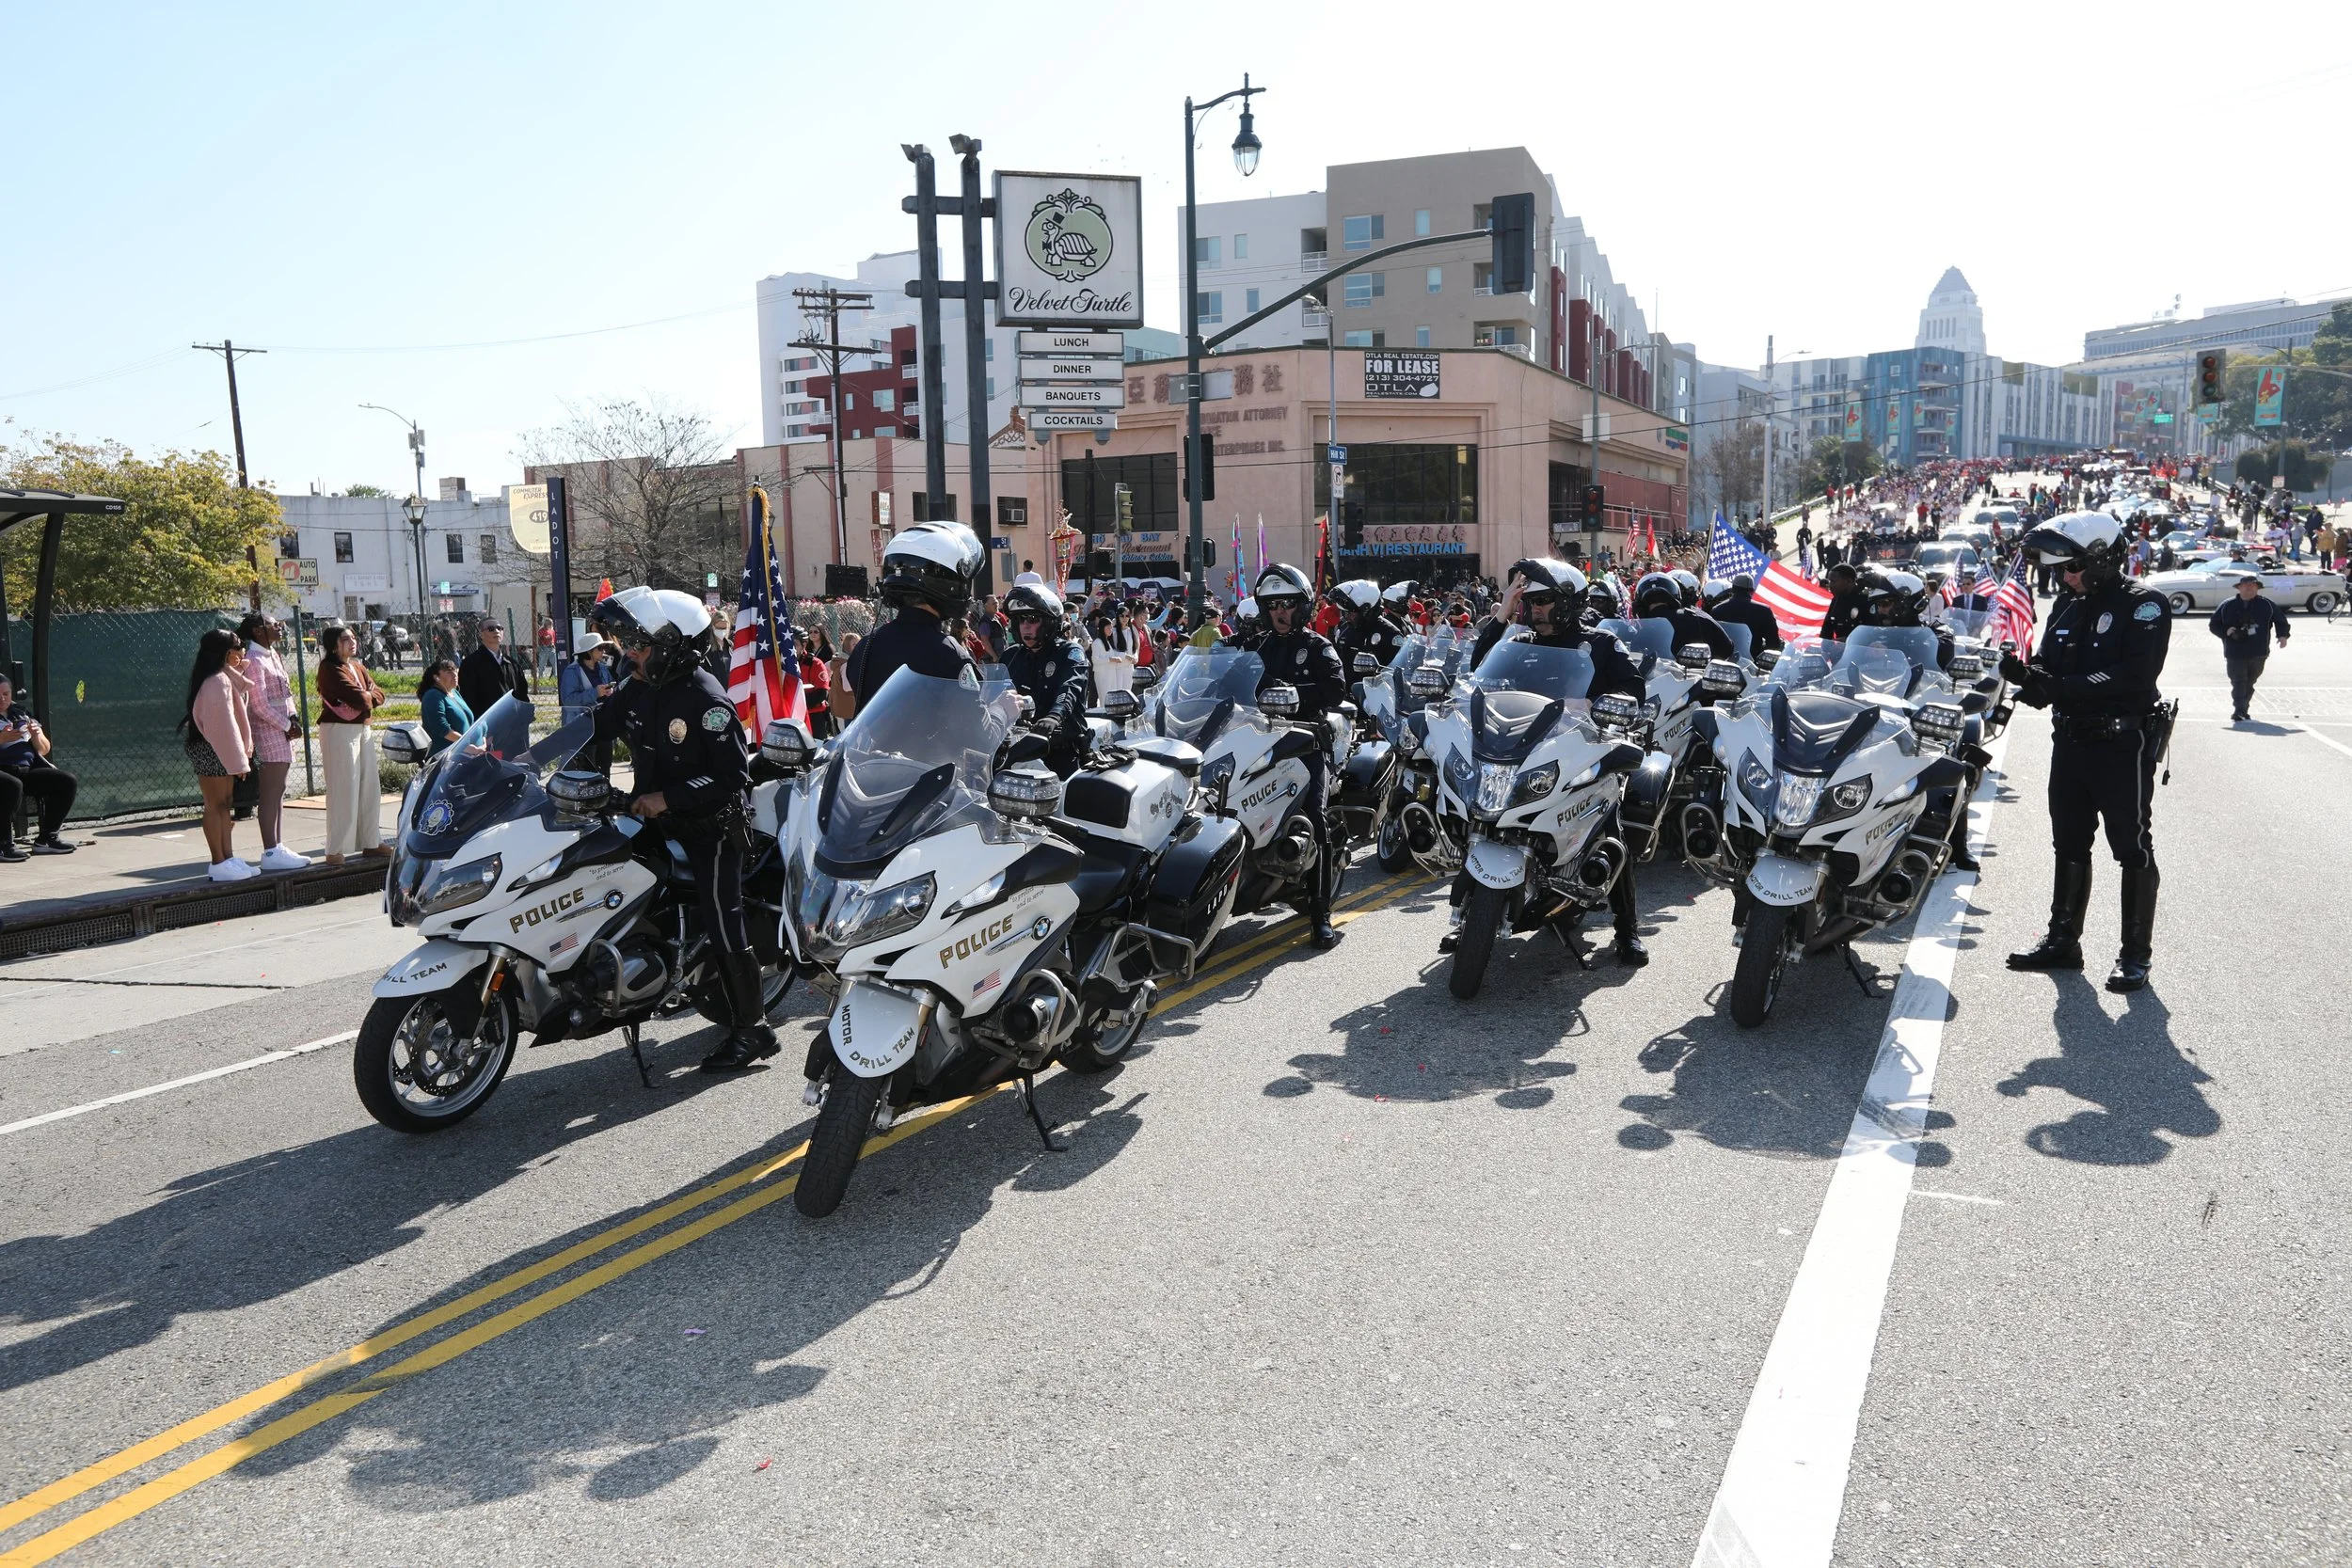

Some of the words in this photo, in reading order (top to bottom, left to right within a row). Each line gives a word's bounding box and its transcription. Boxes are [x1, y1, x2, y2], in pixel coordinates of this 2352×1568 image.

[1009, 287, 1071, 312] Velvet
[1070, 289, 1132, 313] Turtle
[1054, 338, 1089, 347] LUNCH
[1053, 365, 1091, 373] DINNER
[1365, 359, 1392, 373] FOR
[1397, 360, 1438, 373] LEASE
[1366, 383, 1417, 391] DTLA
[1045, 391, 1101, 401] BANQUETS
[1044, 416, 1104, 425] COCKTAILS
[1243, 406, 1289, 421] ATTORNEY
[1339, 451, 1345, 460] St
[532, 512, 548, 521] 419
[1386, 542, 1467, 556] RESTAURANT
[707, 707, 730, 718] ANGELES
[1241, 779, 1278, 813] POLICE
[1557, 793, 1595, 827] POLICE
[1470, 853, 1484, 874] MOTOR
[1483, 873, 1511, 883] DRILL
[1509, 864, 1523, 877] TEAM
[1749, 872, 1764, 892] MOTOR
[1763, 889, 1793, 900] DRILL
[1794, 885, 1814, 897] TEAM
[510, 887, 584, 934] POLICE
[940, 913, 1014, 969] POLICE
[383, 974, 407, 984] RILL
[410, 962, 447, 981] TEAM
[841, 1004, 852, 1047] MOTOR
[850, 1050, 892, 1069] DRILL
[892, 1026, 915, 1054] TEAM
